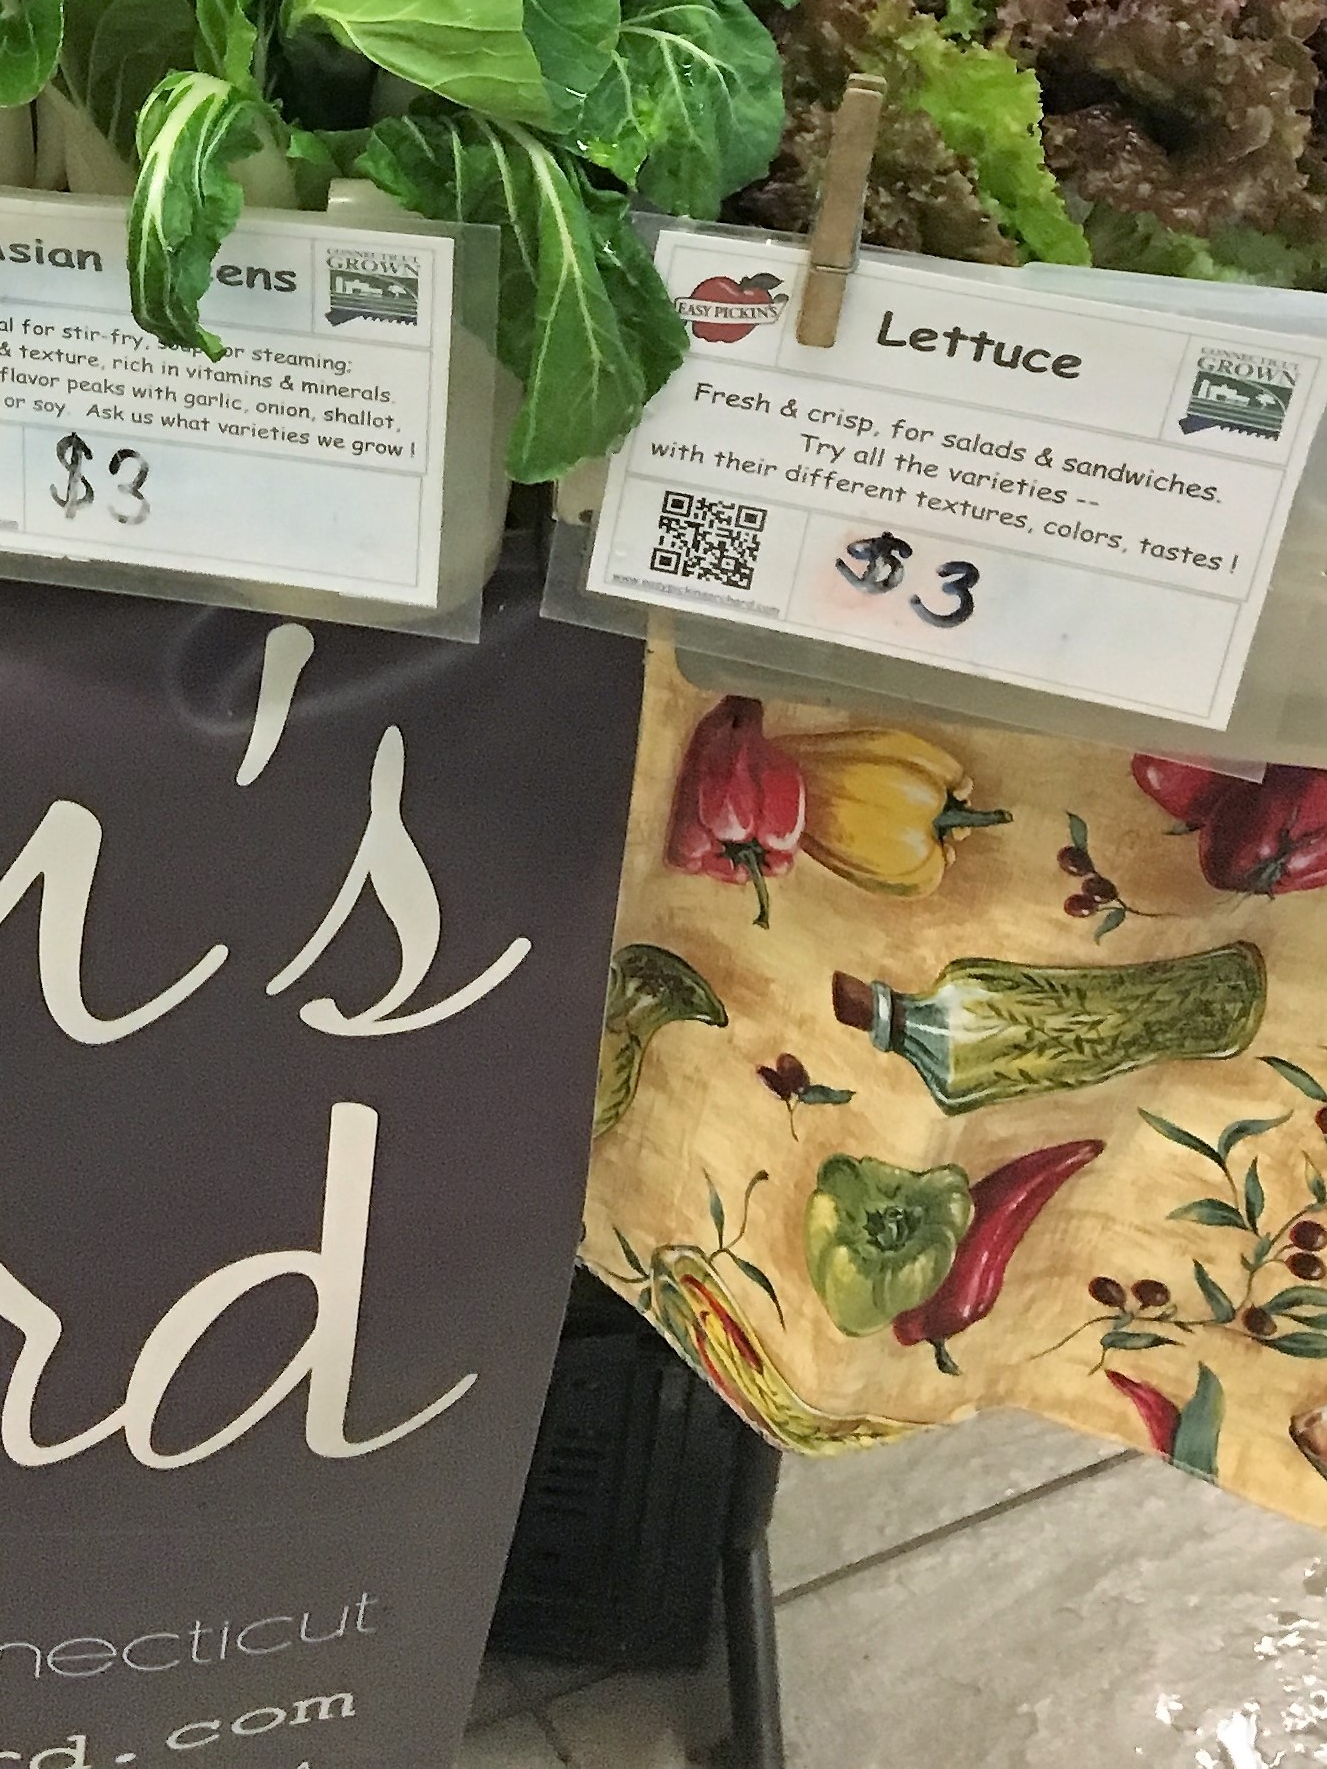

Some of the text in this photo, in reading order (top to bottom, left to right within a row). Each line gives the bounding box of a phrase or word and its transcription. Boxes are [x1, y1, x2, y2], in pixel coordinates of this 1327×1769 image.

[326, 256, 420, 276] GROWN
[22, 319, 55, 336] for
[679, 303, 777, 319] EASY PICKIN'S
[19, 344, 105, 371] texture,
[112, 357, 153, 374] rich
[162, 362, 179, 376] in
[186, 365, 272, 388] vitamins
[301, 380, 395, 404] minerals.
[876, 311, 1083, 379] Lettuce
[1197, 356, 1302, 387] GROWN
[0, 367, 60, 388] flavor
[67, 378, 124, 395] peaks
[132, 384, 176, 402] with
[184, 393, 248, 413] garlic,
[256, 401, 315, 422] onion,
[324, 407, 401, 432] shallot,
[4, 395, 25, 409] or
[86, 404, 124, 421] Ask
[132, 409, 153, 424] us
[161, 414, 210, 432] what
[218, 422, 310, 445] varieties
[318, 435, 345, 449] we
[352, 439, 403, 456] grow
[694, 382, 1223, 504] Fresh crisp, for salads sandwiches.
[801, 433, 1068, 504] Try all the varieties
[651, 441, 1223, 571] with their different textures, colors, tastes
